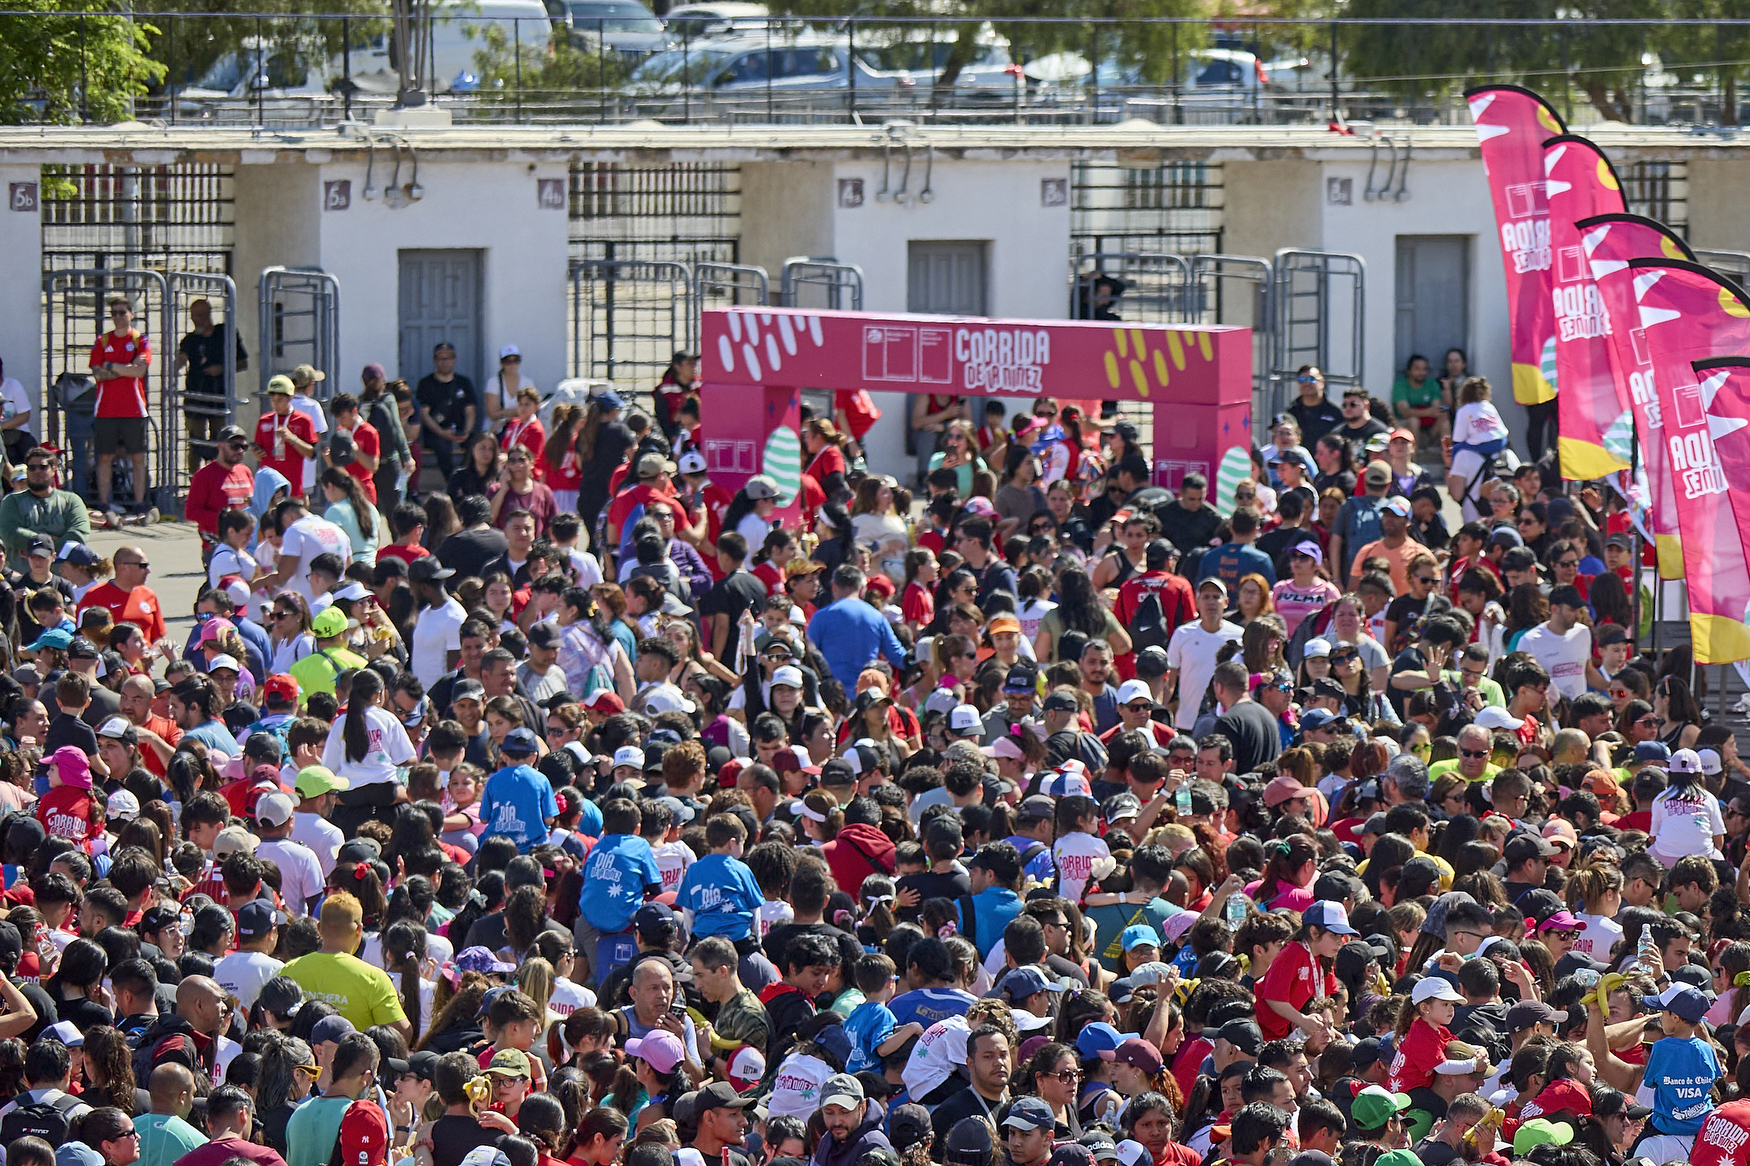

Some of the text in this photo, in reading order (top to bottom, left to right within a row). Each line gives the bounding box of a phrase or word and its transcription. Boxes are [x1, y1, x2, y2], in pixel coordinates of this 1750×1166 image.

[956, 328, 1050, 366] CORRIDA
[965, 364, 986, 385] DE
[500, 803, 517, 822] DÍA
[595, 851, 613, 869] DÍA
[701, 883, 722, 906] DÍA
[1663, 1076, 1712, 1085] Banco de Chile
[1676, 1088, 1703, 1099] VISA
[1706, 1114, 1750, 1146] CORRIDA
[1087, 1141, 1115, 1151] adidas
